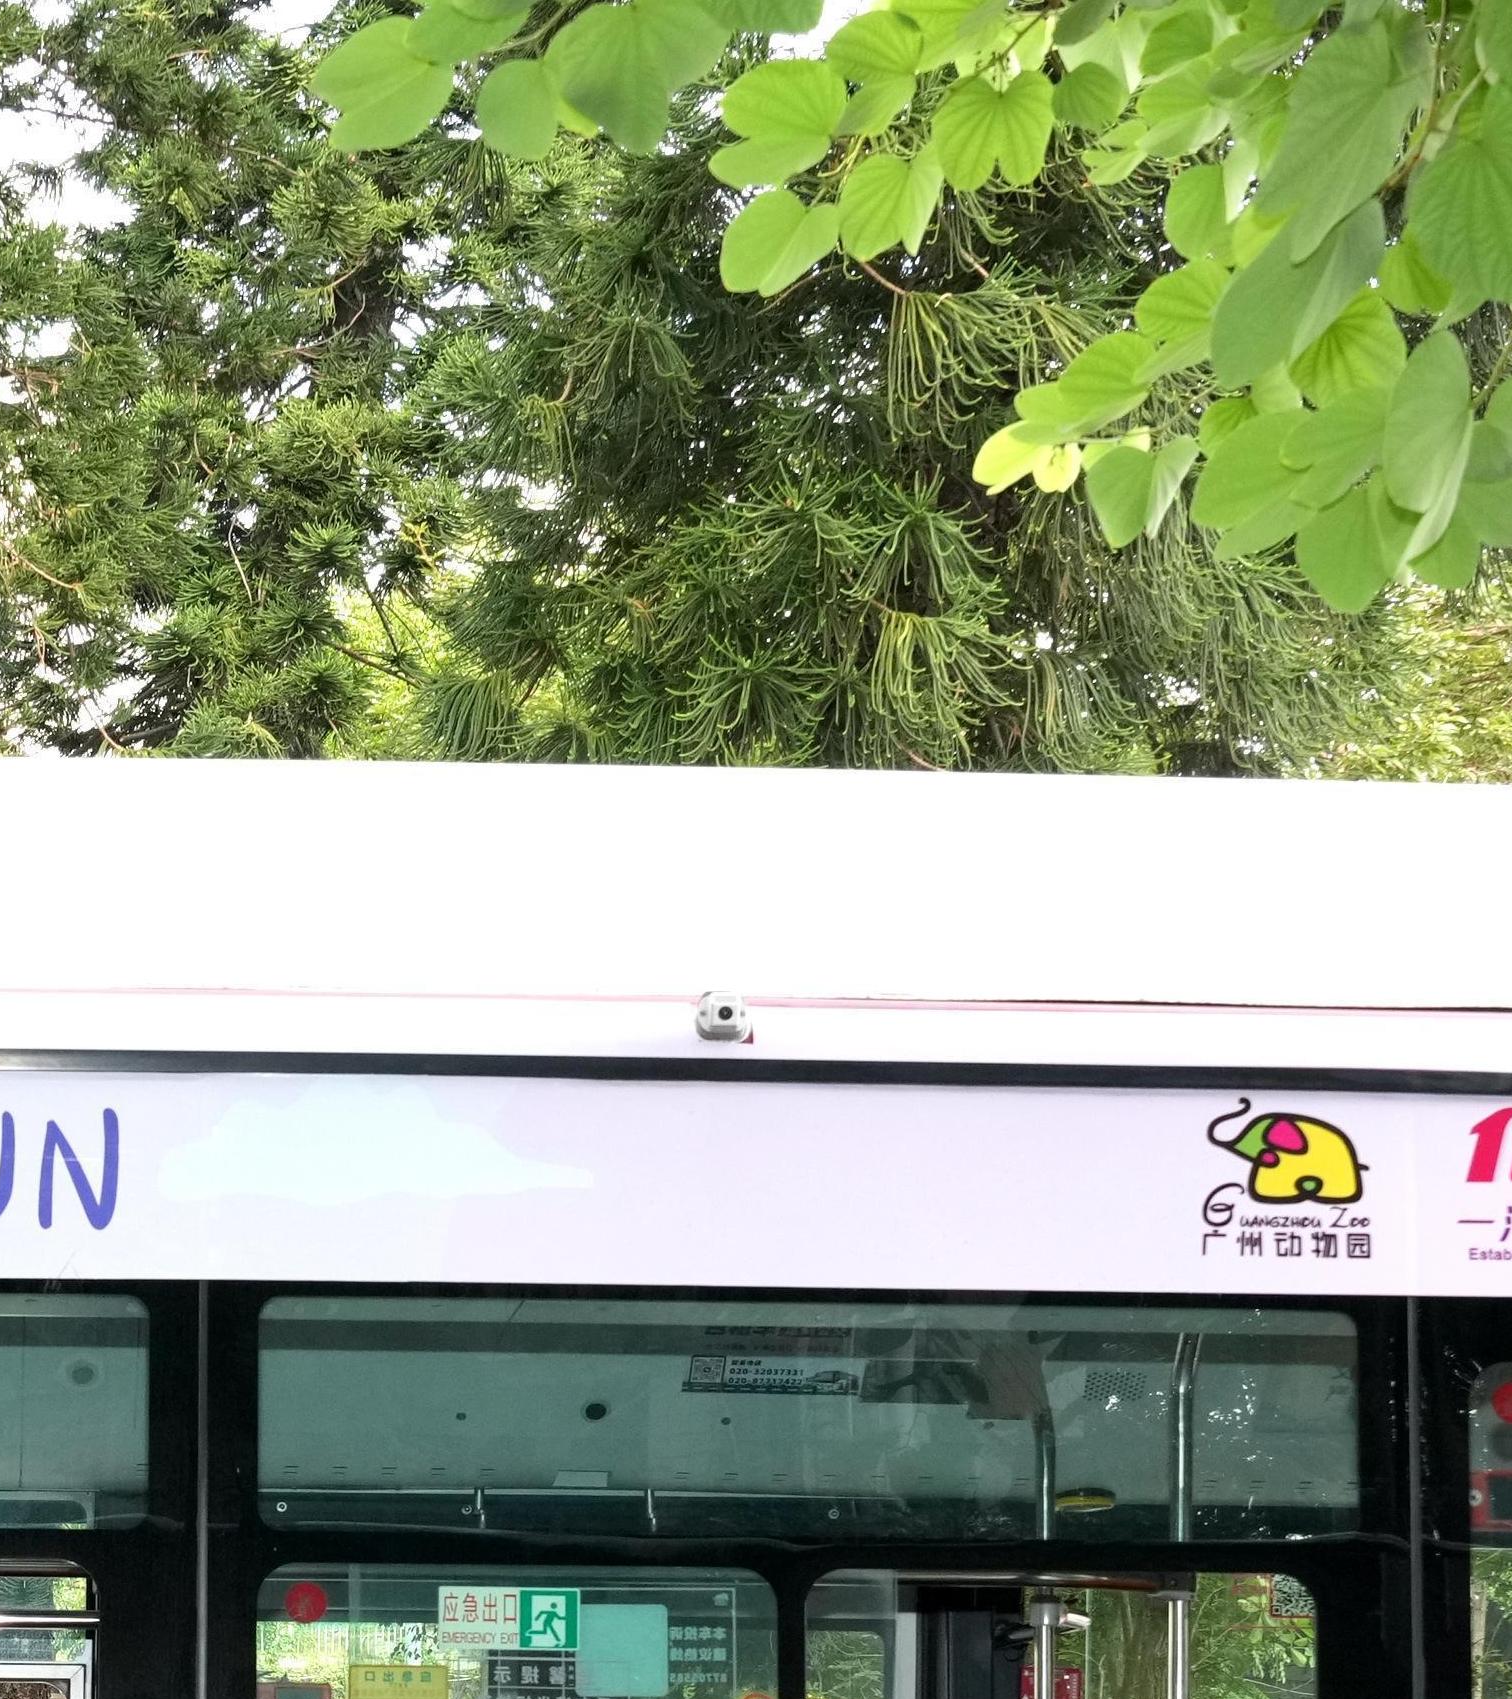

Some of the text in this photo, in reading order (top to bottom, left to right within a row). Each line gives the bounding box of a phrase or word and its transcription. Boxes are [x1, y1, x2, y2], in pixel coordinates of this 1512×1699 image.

[1202, 1229, 1372, 1260] 广州动物园
[442, 1592, 517, 1624] 应急出口
[441, 1631, 519, 1645] EMERGENCY EXIT
